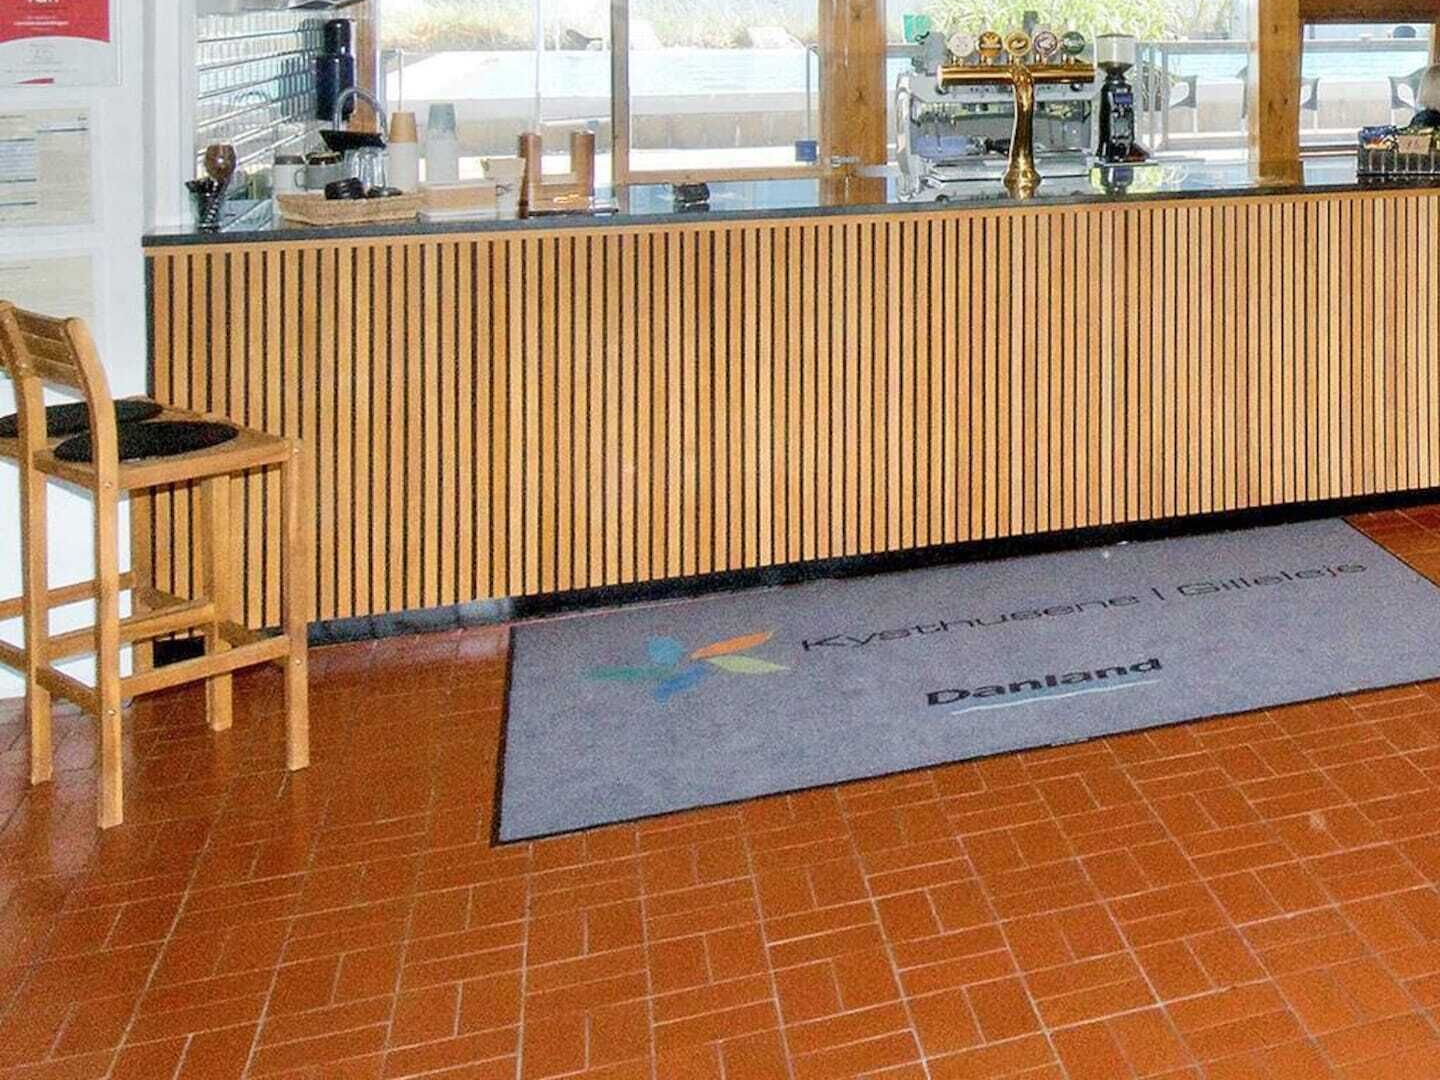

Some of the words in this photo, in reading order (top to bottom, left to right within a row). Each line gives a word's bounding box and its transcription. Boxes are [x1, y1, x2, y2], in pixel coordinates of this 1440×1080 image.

[801, 593, 1140, 652] Kysthusene
[1175, 562, 1368, 598] Gilleleje
[925, 657, 1163, 707] Danland
